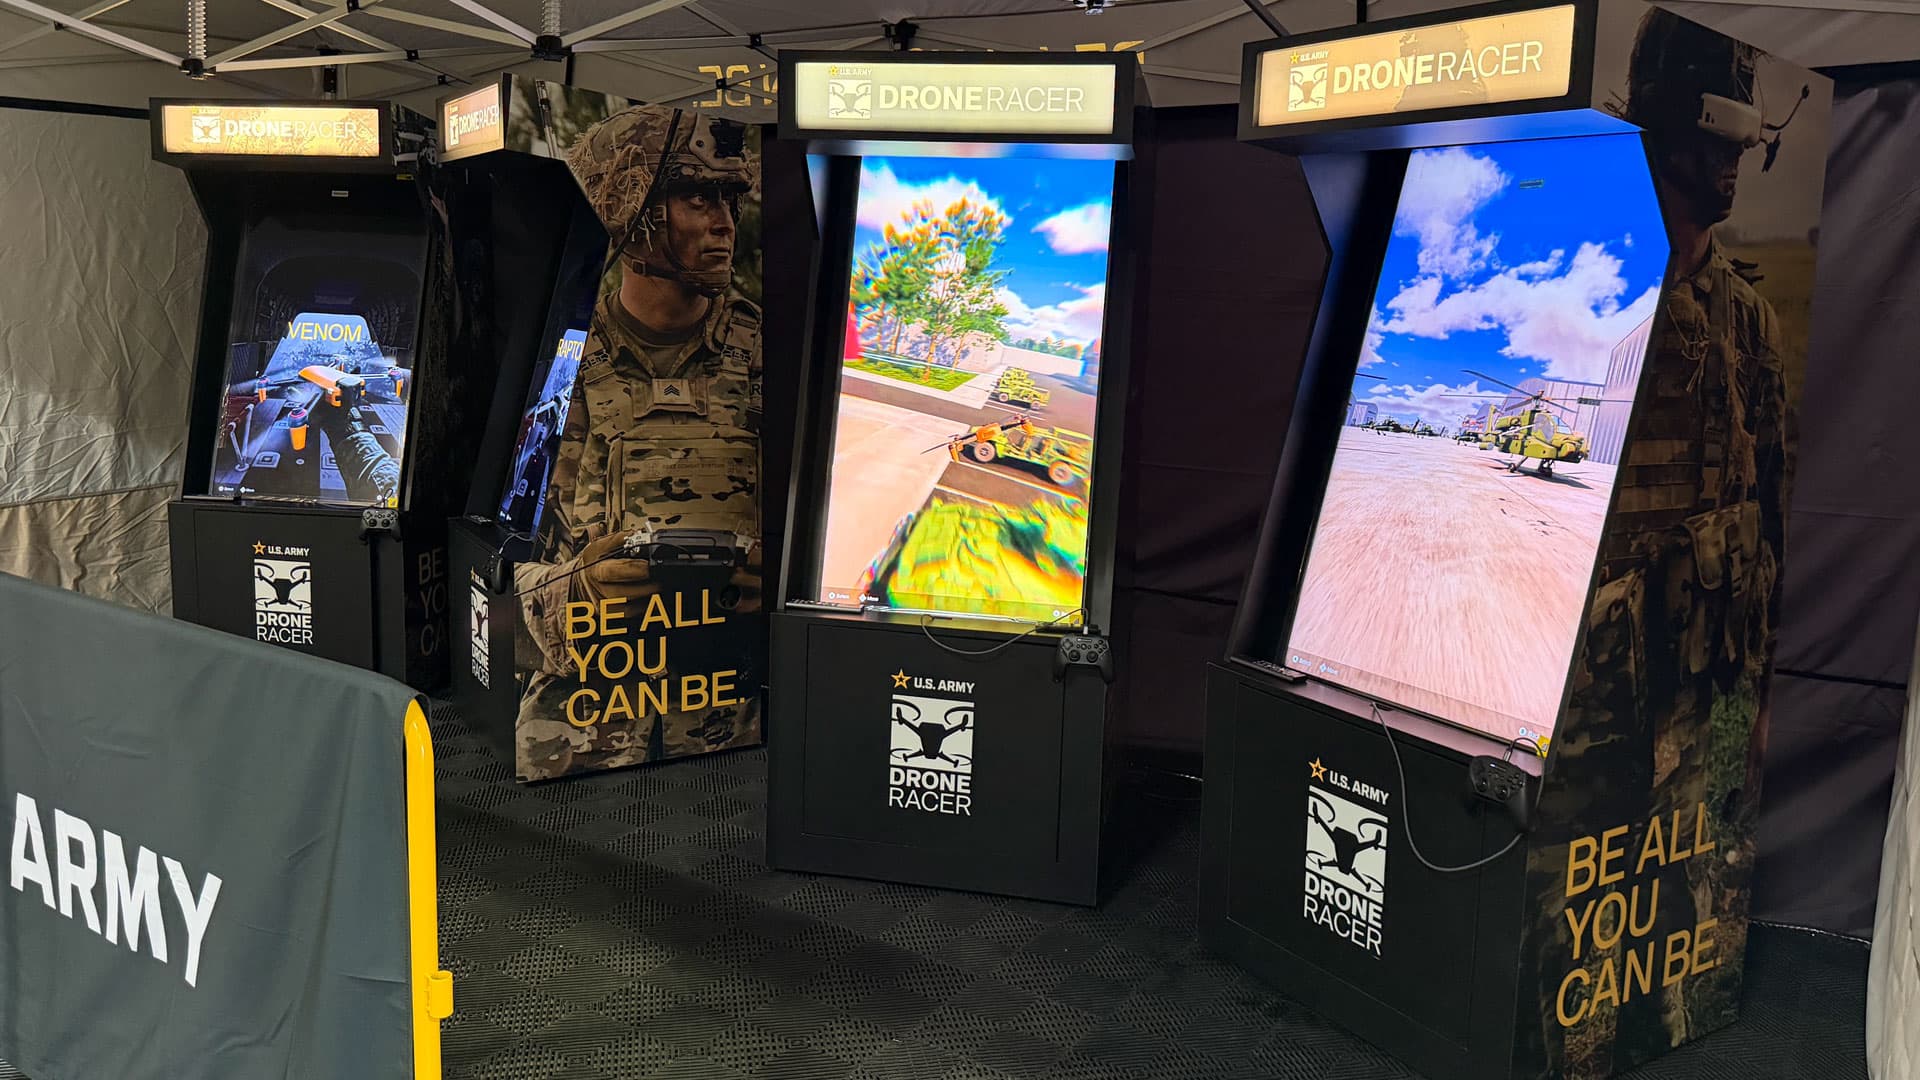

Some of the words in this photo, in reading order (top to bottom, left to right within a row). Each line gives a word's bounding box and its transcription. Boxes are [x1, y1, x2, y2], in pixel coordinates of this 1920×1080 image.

[288, 321, 362, 342] VENOM
[556, 338, 585, 361] RAPTO
[268, 545, 283, 555] U.S.
[284, 547, 310, 556] ARMY
[418, 549, 443, 585] BE
[420, 583, 447, 619] YO
[565, 597, 628, 640] BE
[640, 589, 726, 632] ALL
[256, 611, 312, 629] DRONE
[256, 626, 313, 645] RACER
[567, 636, 667, 683] YOU
[566, 678, 668, 727] CAN
[681, 669, 745, 712] BE.
[914, 677, 936, 690] U.S.
[938, 679, 975, 694] ARMY
[890, 767, 971, 794] DRONE
[1329, 770, 1350, 790] U.S.
[1352, 780, 1390, 806] ARMY
[889, 786, 971, 816] RACER
[1566, 824, 1629, 898] BE
[1635, 802, 1716, 875] ALL
[10, 792, 223, 988] ARMY
[1305, 871, 1383, 929] DRONE
[1304, 894, 1382, 956] RACER
[1564, 878, 1660, 960] YOU
[1556, 941, 1655, 1027] CAN
[1662, 918, 1722, 987] BE.
